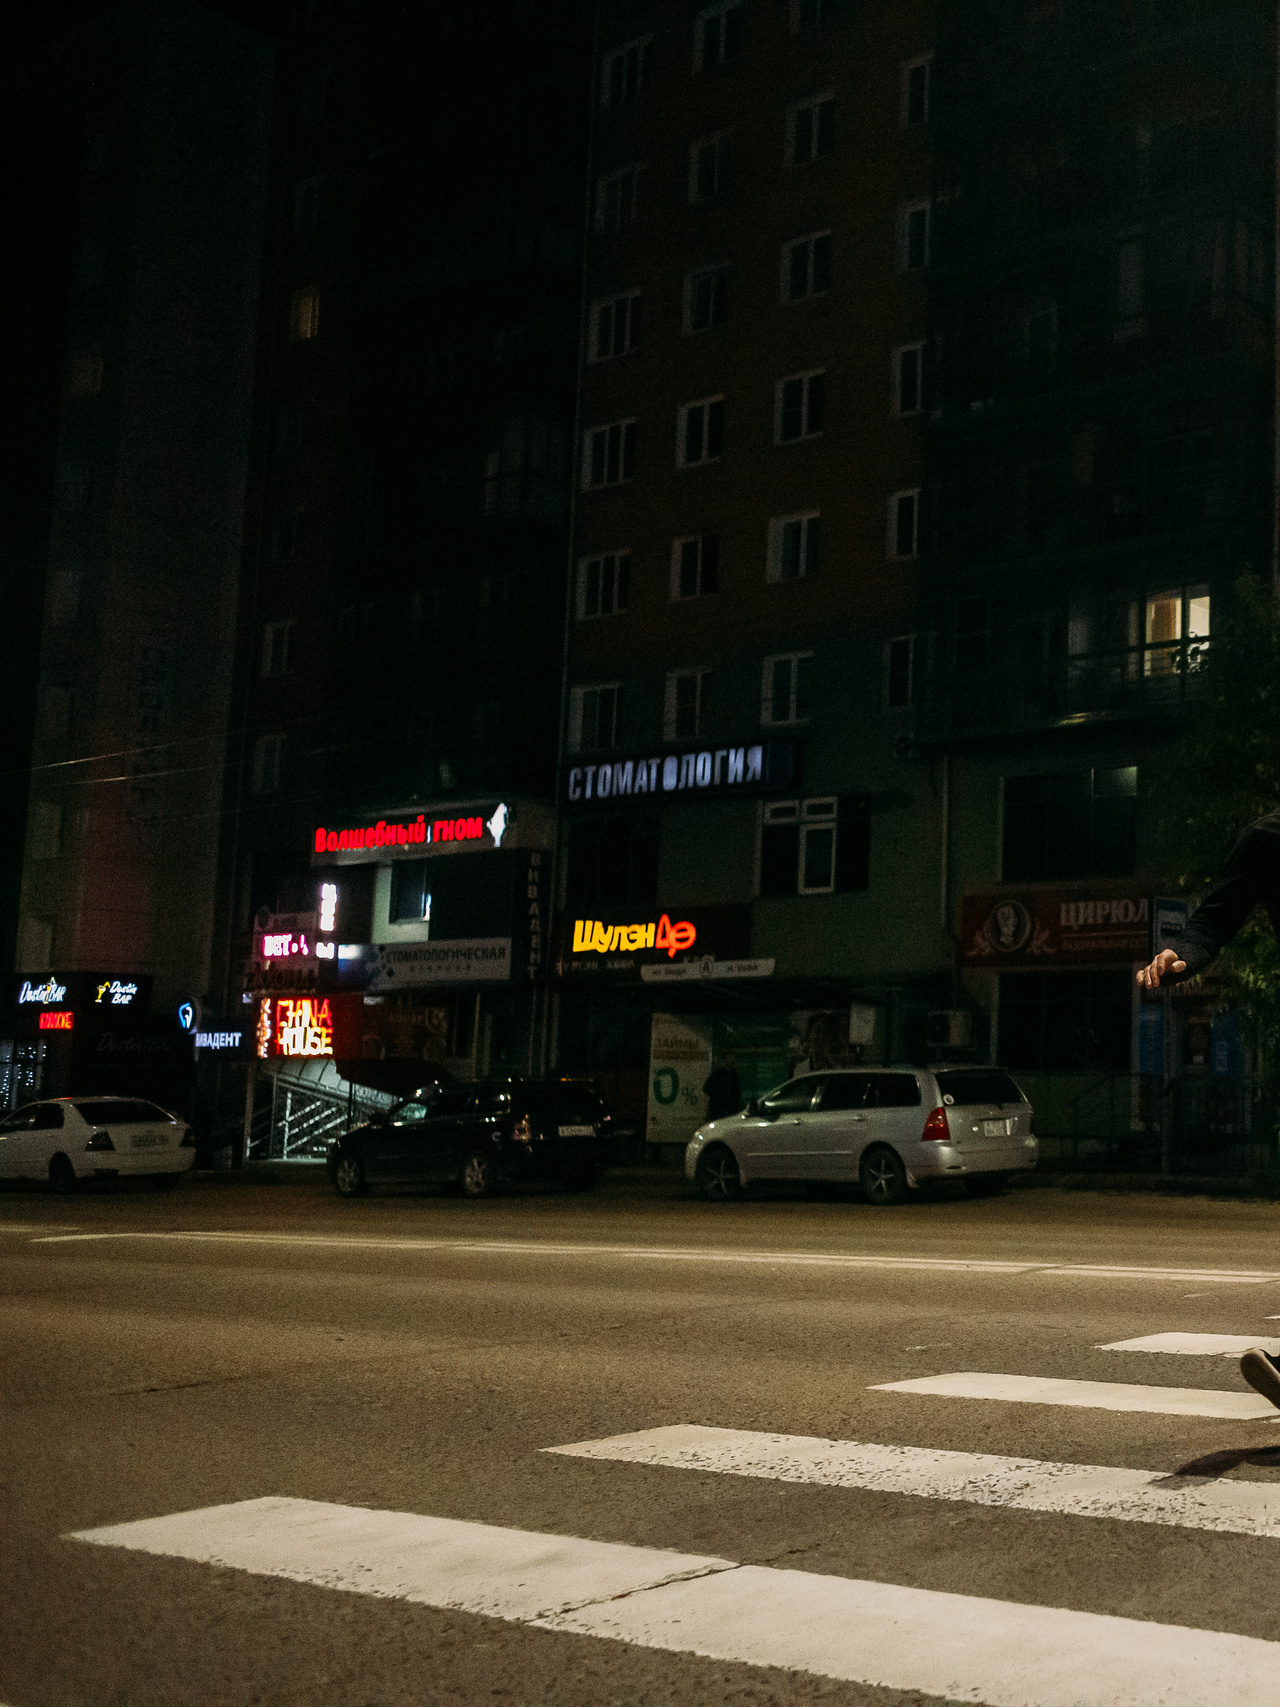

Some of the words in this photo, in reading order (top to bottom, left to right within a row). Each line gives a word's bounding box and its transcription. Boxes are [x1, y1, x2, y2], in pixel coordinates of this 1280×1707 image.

[568, 745, 763, 801] СТОМАТОЛОГИЯ
[315, 815, 426, 853] Волшебный
[433, 816, 483, 843] гном
[111, 993, 133, 1004] BAR
[276, 998, 333, 1027] CHINA
[276, 1024, 334, 1057] HOUSE
